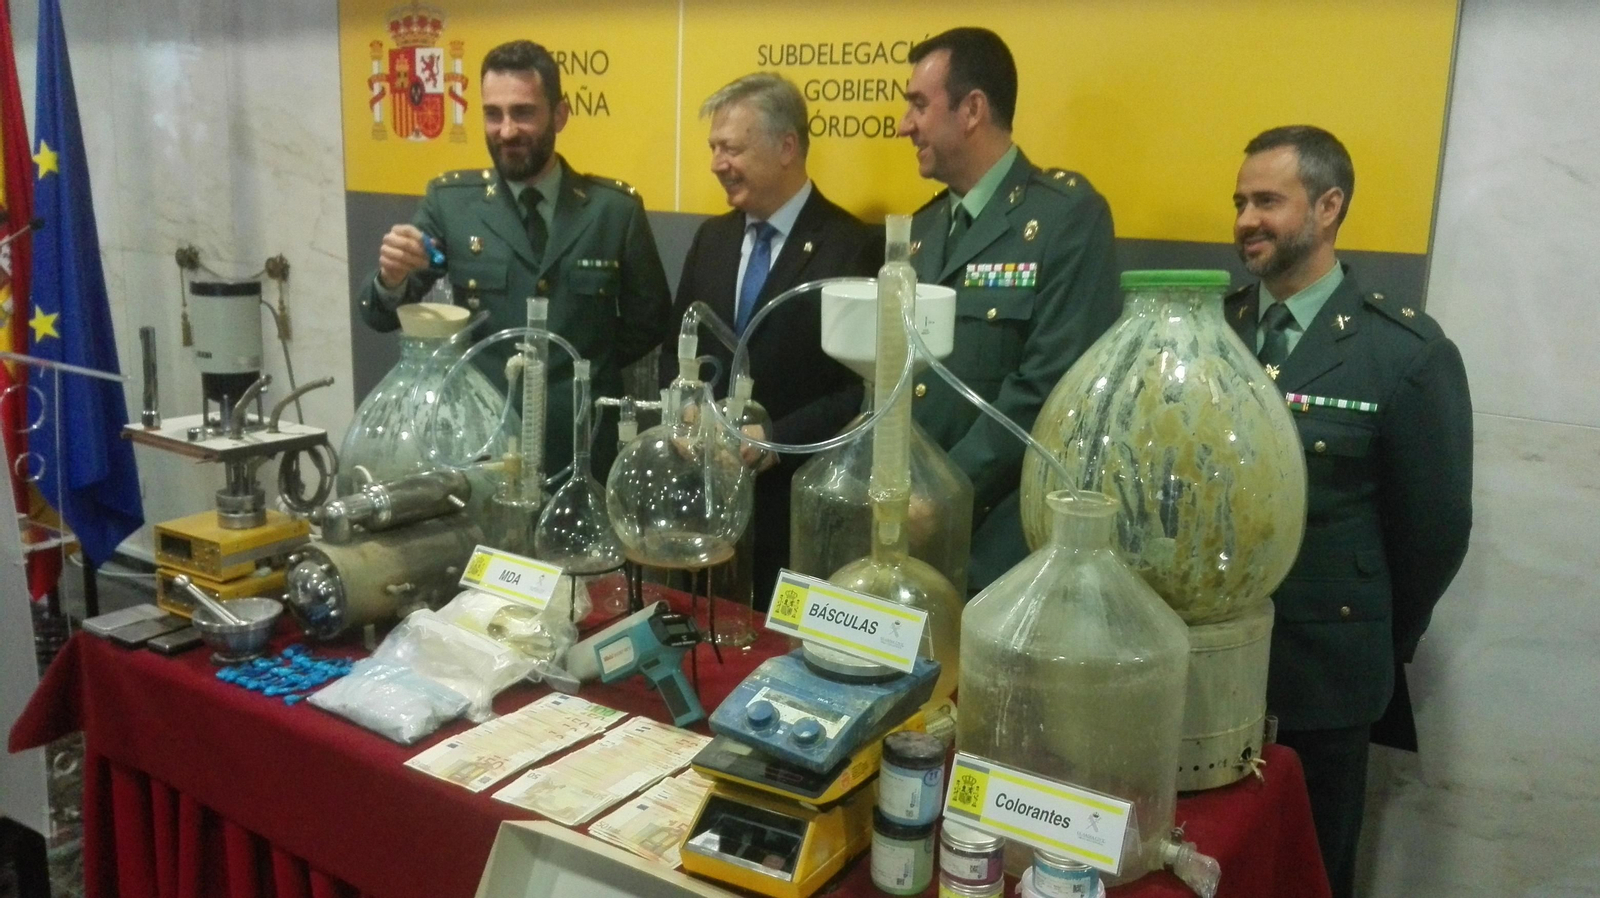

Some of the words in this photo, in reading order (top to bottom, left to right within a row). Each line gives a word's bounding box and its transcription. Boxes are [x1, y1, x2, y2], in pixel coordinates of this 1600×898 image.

[549, 49, 609, 75] RNO
[757, 36, 929, 66] SUBDELEGAC
[562, 85, 610, 116] AÑA
[804, 78, 910, 102] GOBIERN
[808, 109, 900, 138] ÓRDOB
[498, 569, 521, 585] MDA
[808, 603, 879, 635] BÁSCULAS
[995, 792, 1071, 829] Colorantes
